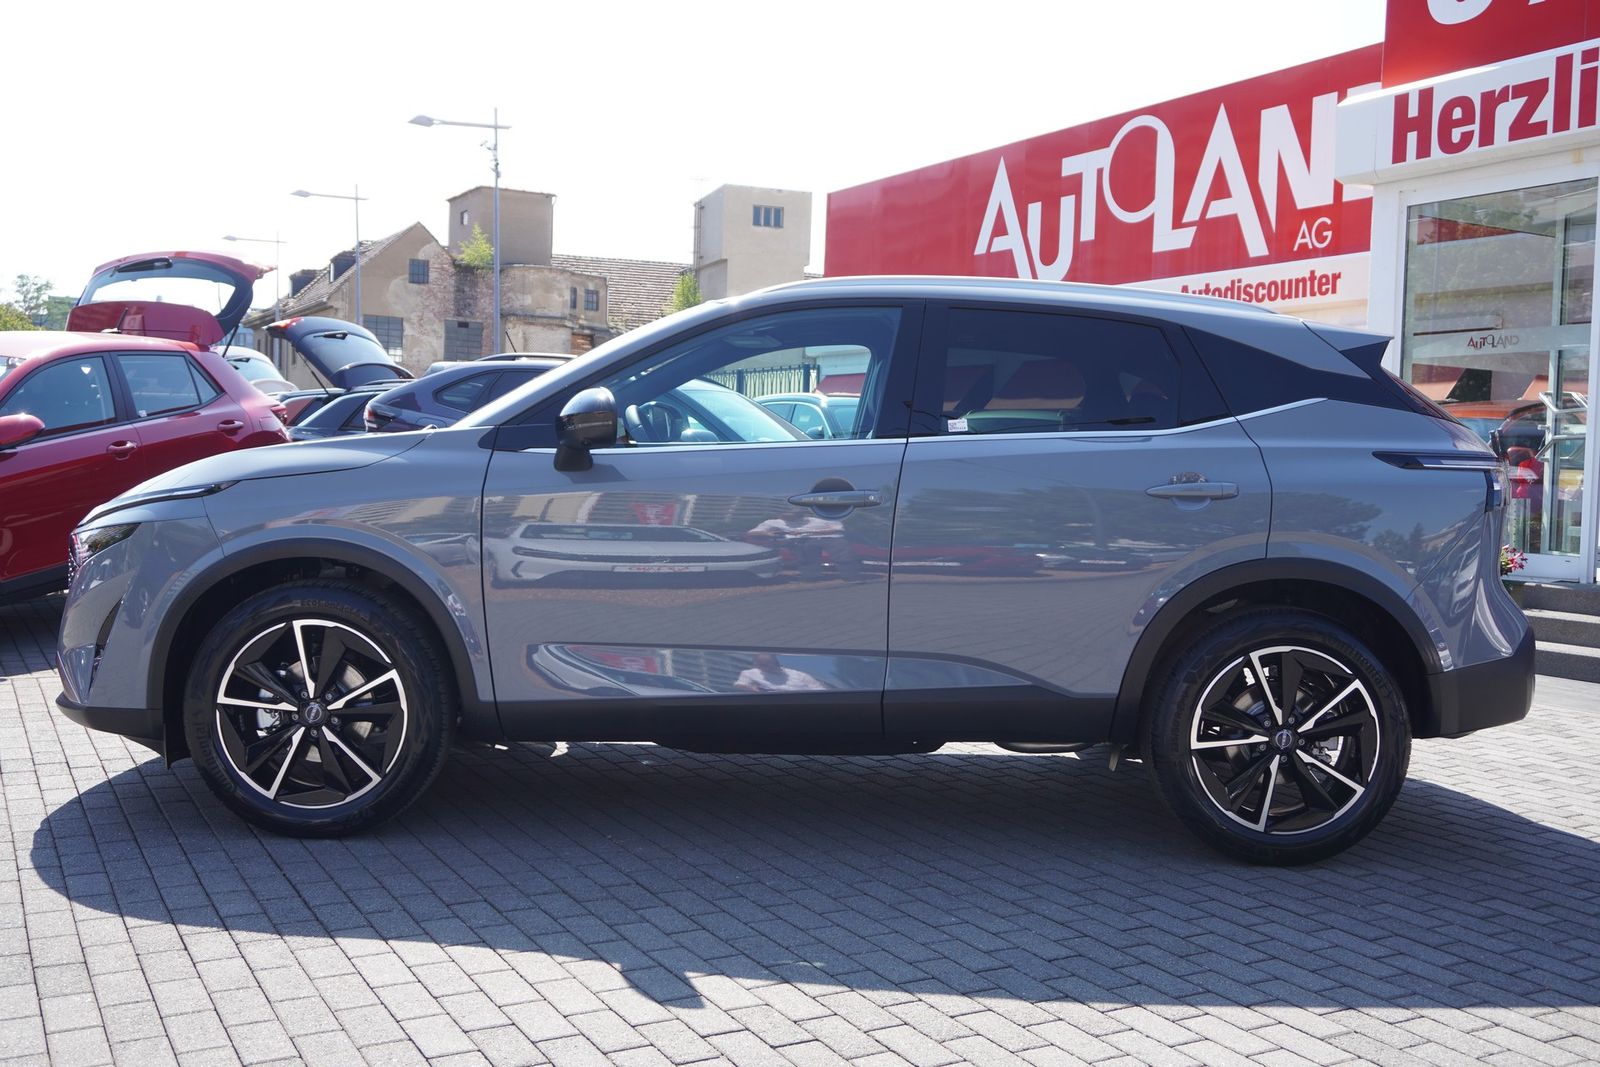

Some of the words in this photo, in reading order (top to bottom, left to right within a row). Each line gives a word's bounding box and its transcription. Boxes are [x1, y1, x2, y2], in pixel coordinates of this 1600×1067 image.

[1392, 47, 1600, 164] Herzli
[974, 82, 1381, 280] AUTOLAN
[1293, 217, 1333, 251] AG
[1180, 270, 1342, 304] todiscounter
